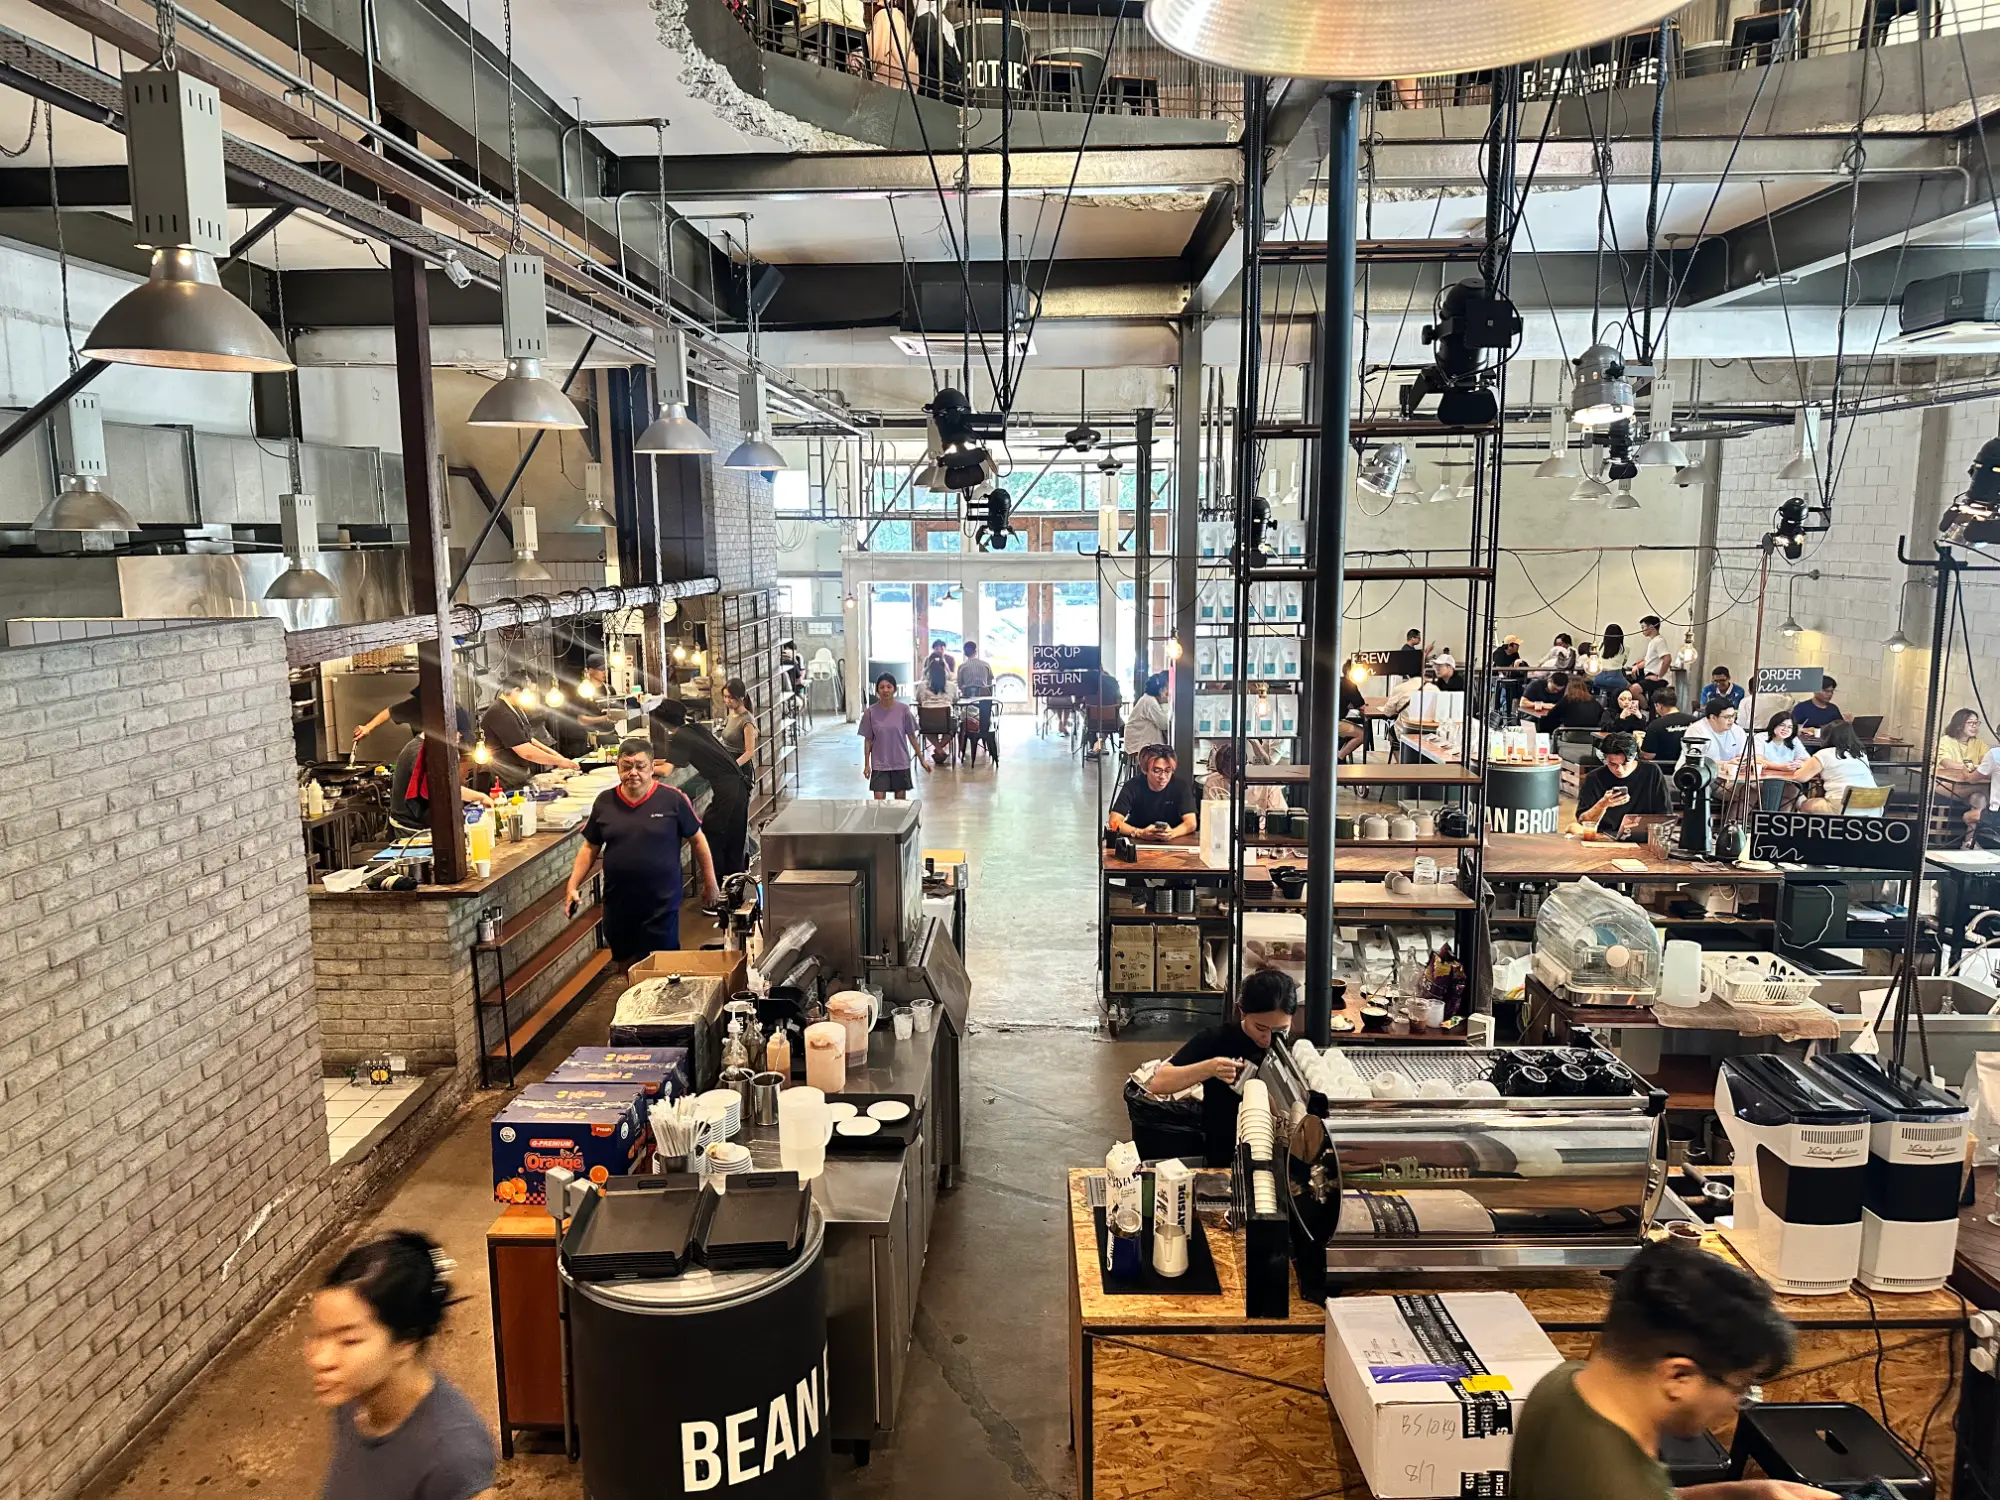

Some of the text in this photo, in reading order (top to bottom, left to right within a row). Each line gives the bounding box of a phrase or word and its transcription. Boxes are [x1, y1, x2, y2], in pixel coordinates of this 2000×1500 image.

[1033, 646, 1081, 658] PICK UP
[1034, 654, 1060, 669] and
[1033, 673, 1082, 685] RETURN
[1758, 669, 1802, 681] ORDER
[1034, 684, 1063, 696] here
[1758, 680, 1787, 692] here
[1754, 814, 1911, 844] ESPRESSO
[1753, 834, 1804, 859] bar
[526, 1154, 583, 1171] Orange
[681, 1366, 820, 1493] BEAN
[1402, 1413, 1424, 1437] BS
[1404, 1459, 1435, 1492] 8/7
